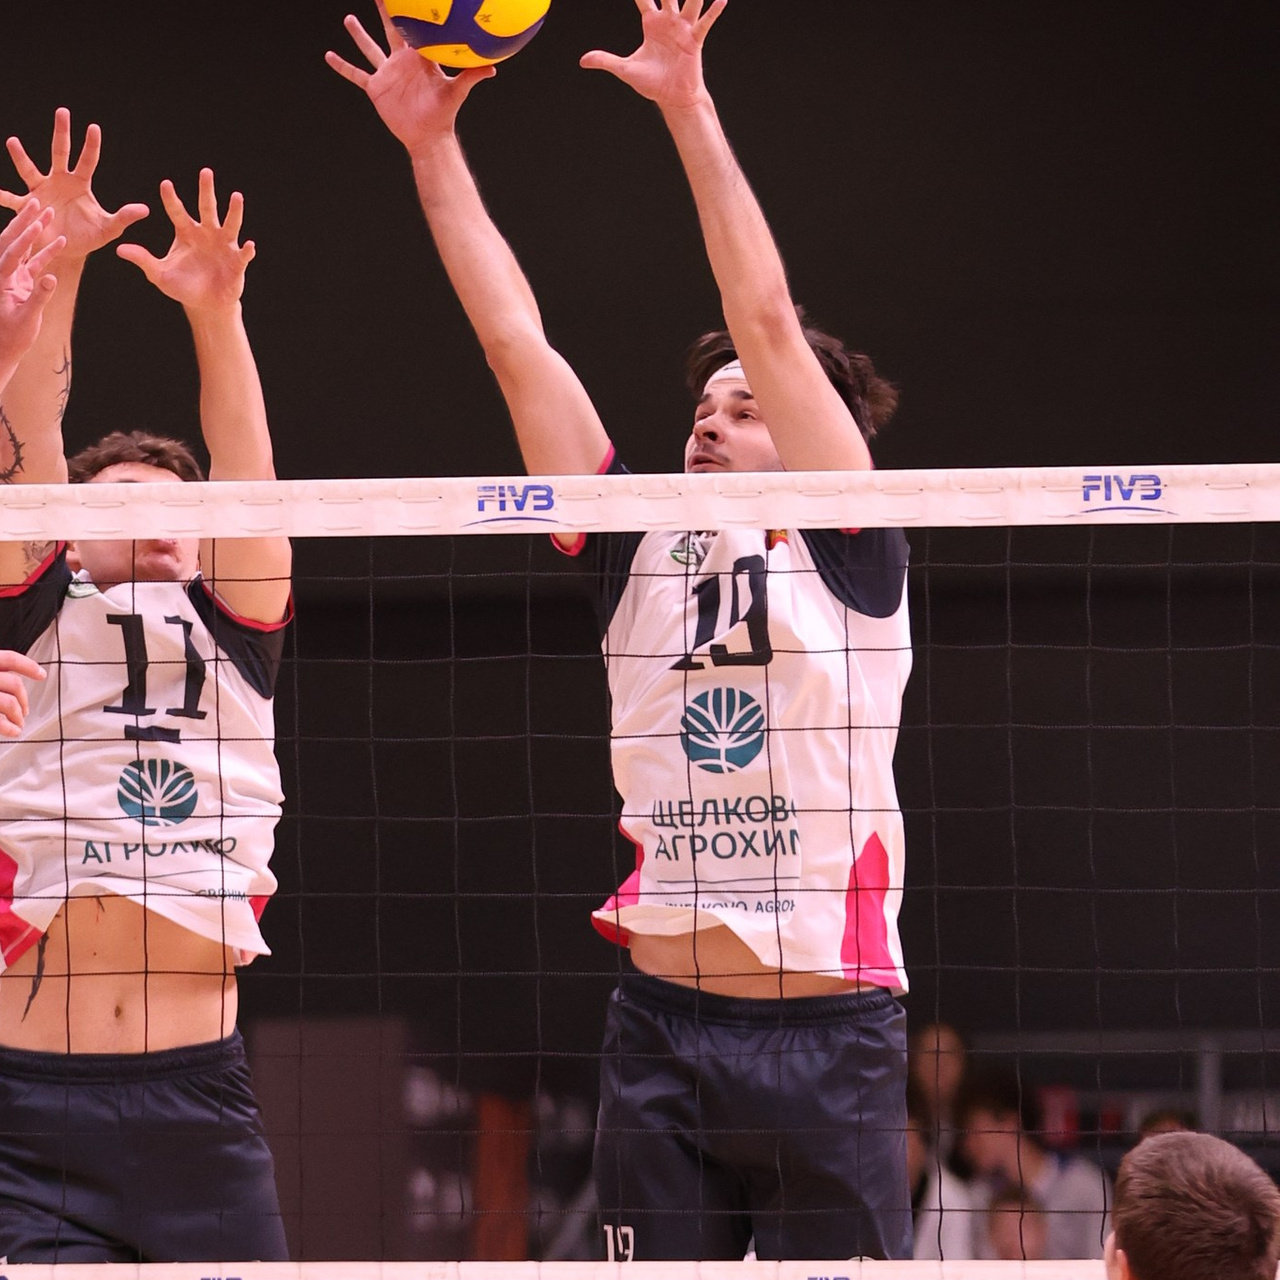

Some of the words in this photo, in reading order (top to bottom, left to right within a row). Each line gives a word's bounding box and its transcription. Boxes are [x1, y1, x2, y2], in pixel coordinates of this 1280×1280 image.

[477, 485, 554, 511] FIVB
[1082, 474, 1162, 501] FIVB
[669, 554, 773, 670] 19
[102, 613, 208, 720] 11
